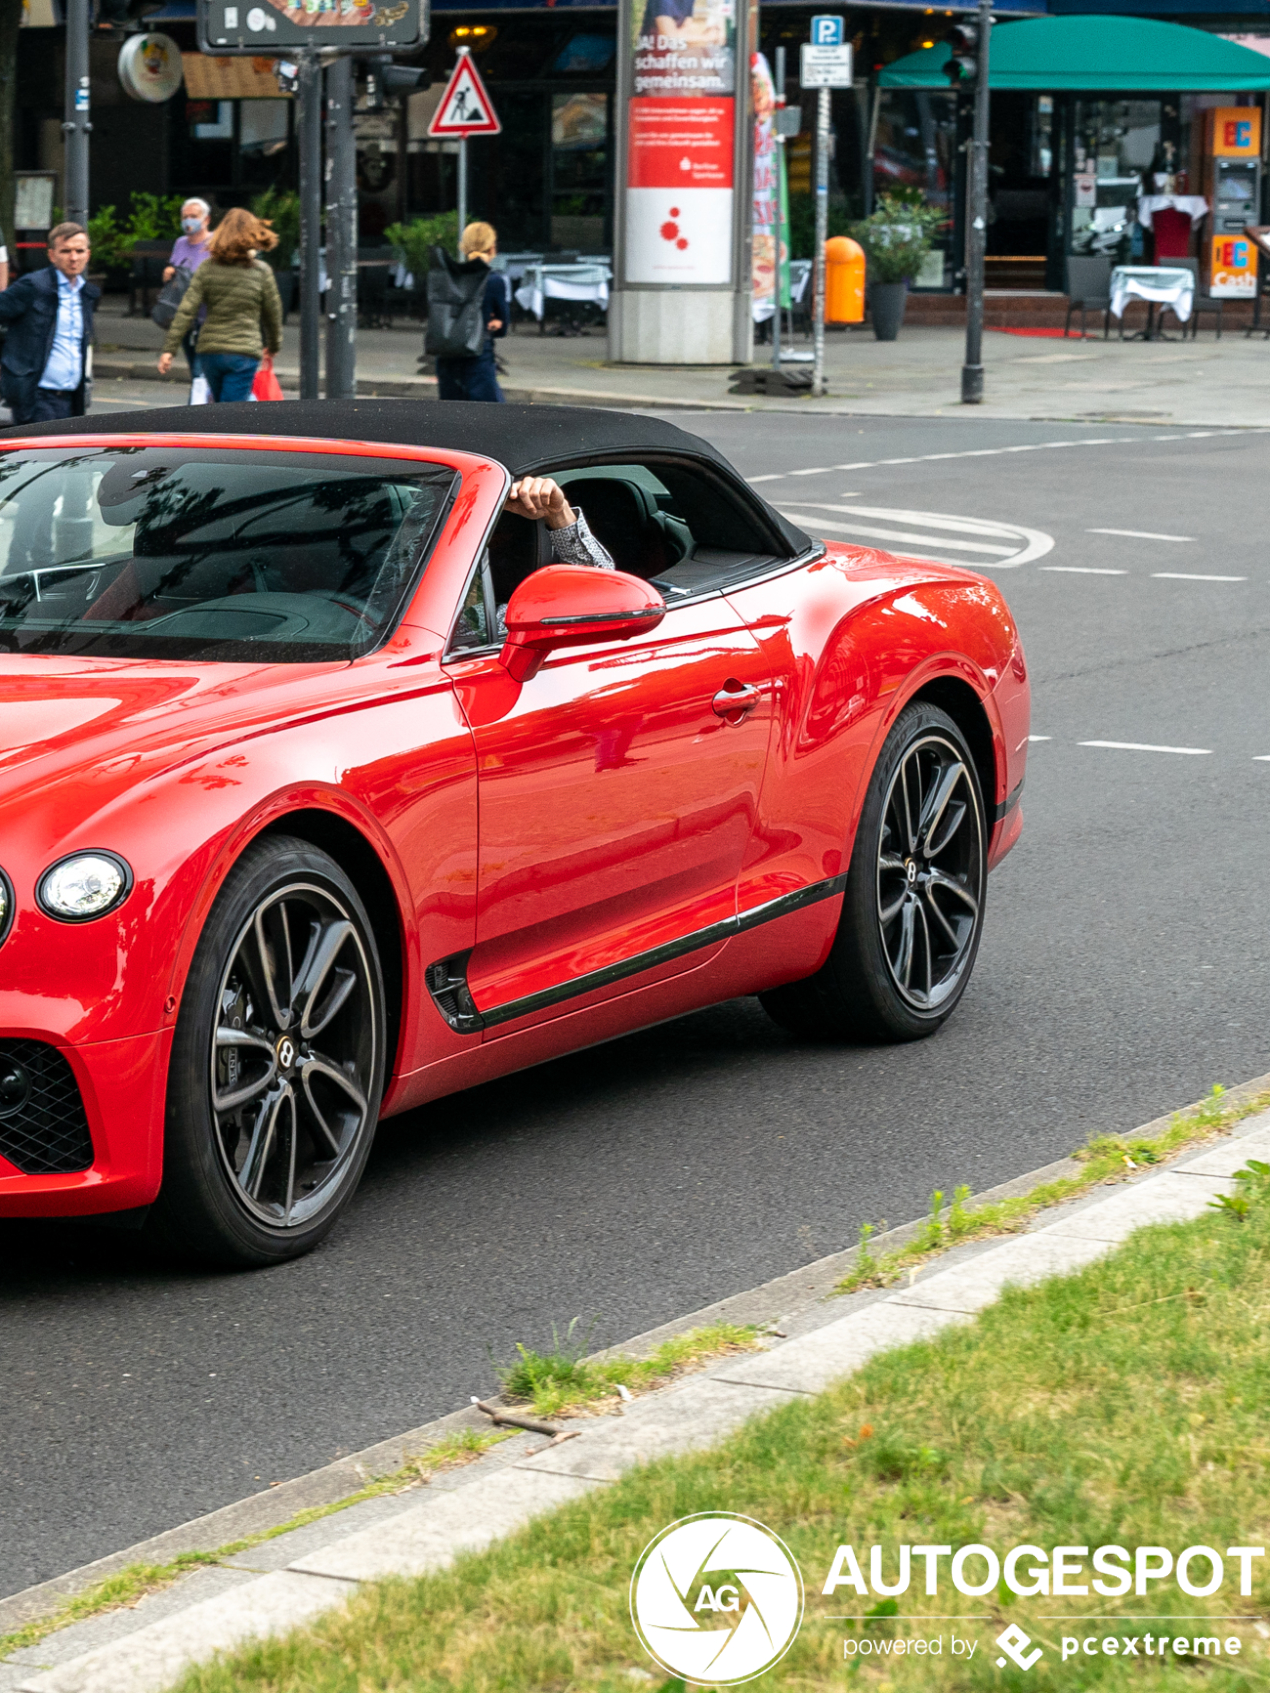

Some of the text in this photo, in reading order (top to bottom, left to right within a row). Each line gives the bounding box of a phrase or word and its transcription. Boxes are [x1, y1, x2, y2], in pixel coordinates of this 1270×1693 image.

[657, 35, 687, 50] Das
[818, 20, 836, 44] P
[635, 53, 727, 69] schaffen wir
[634, 71, 726, 93] gemeinsam.
[1224, 121, 1251, 147] EC
[1223, 242, 1248, 267] EC
